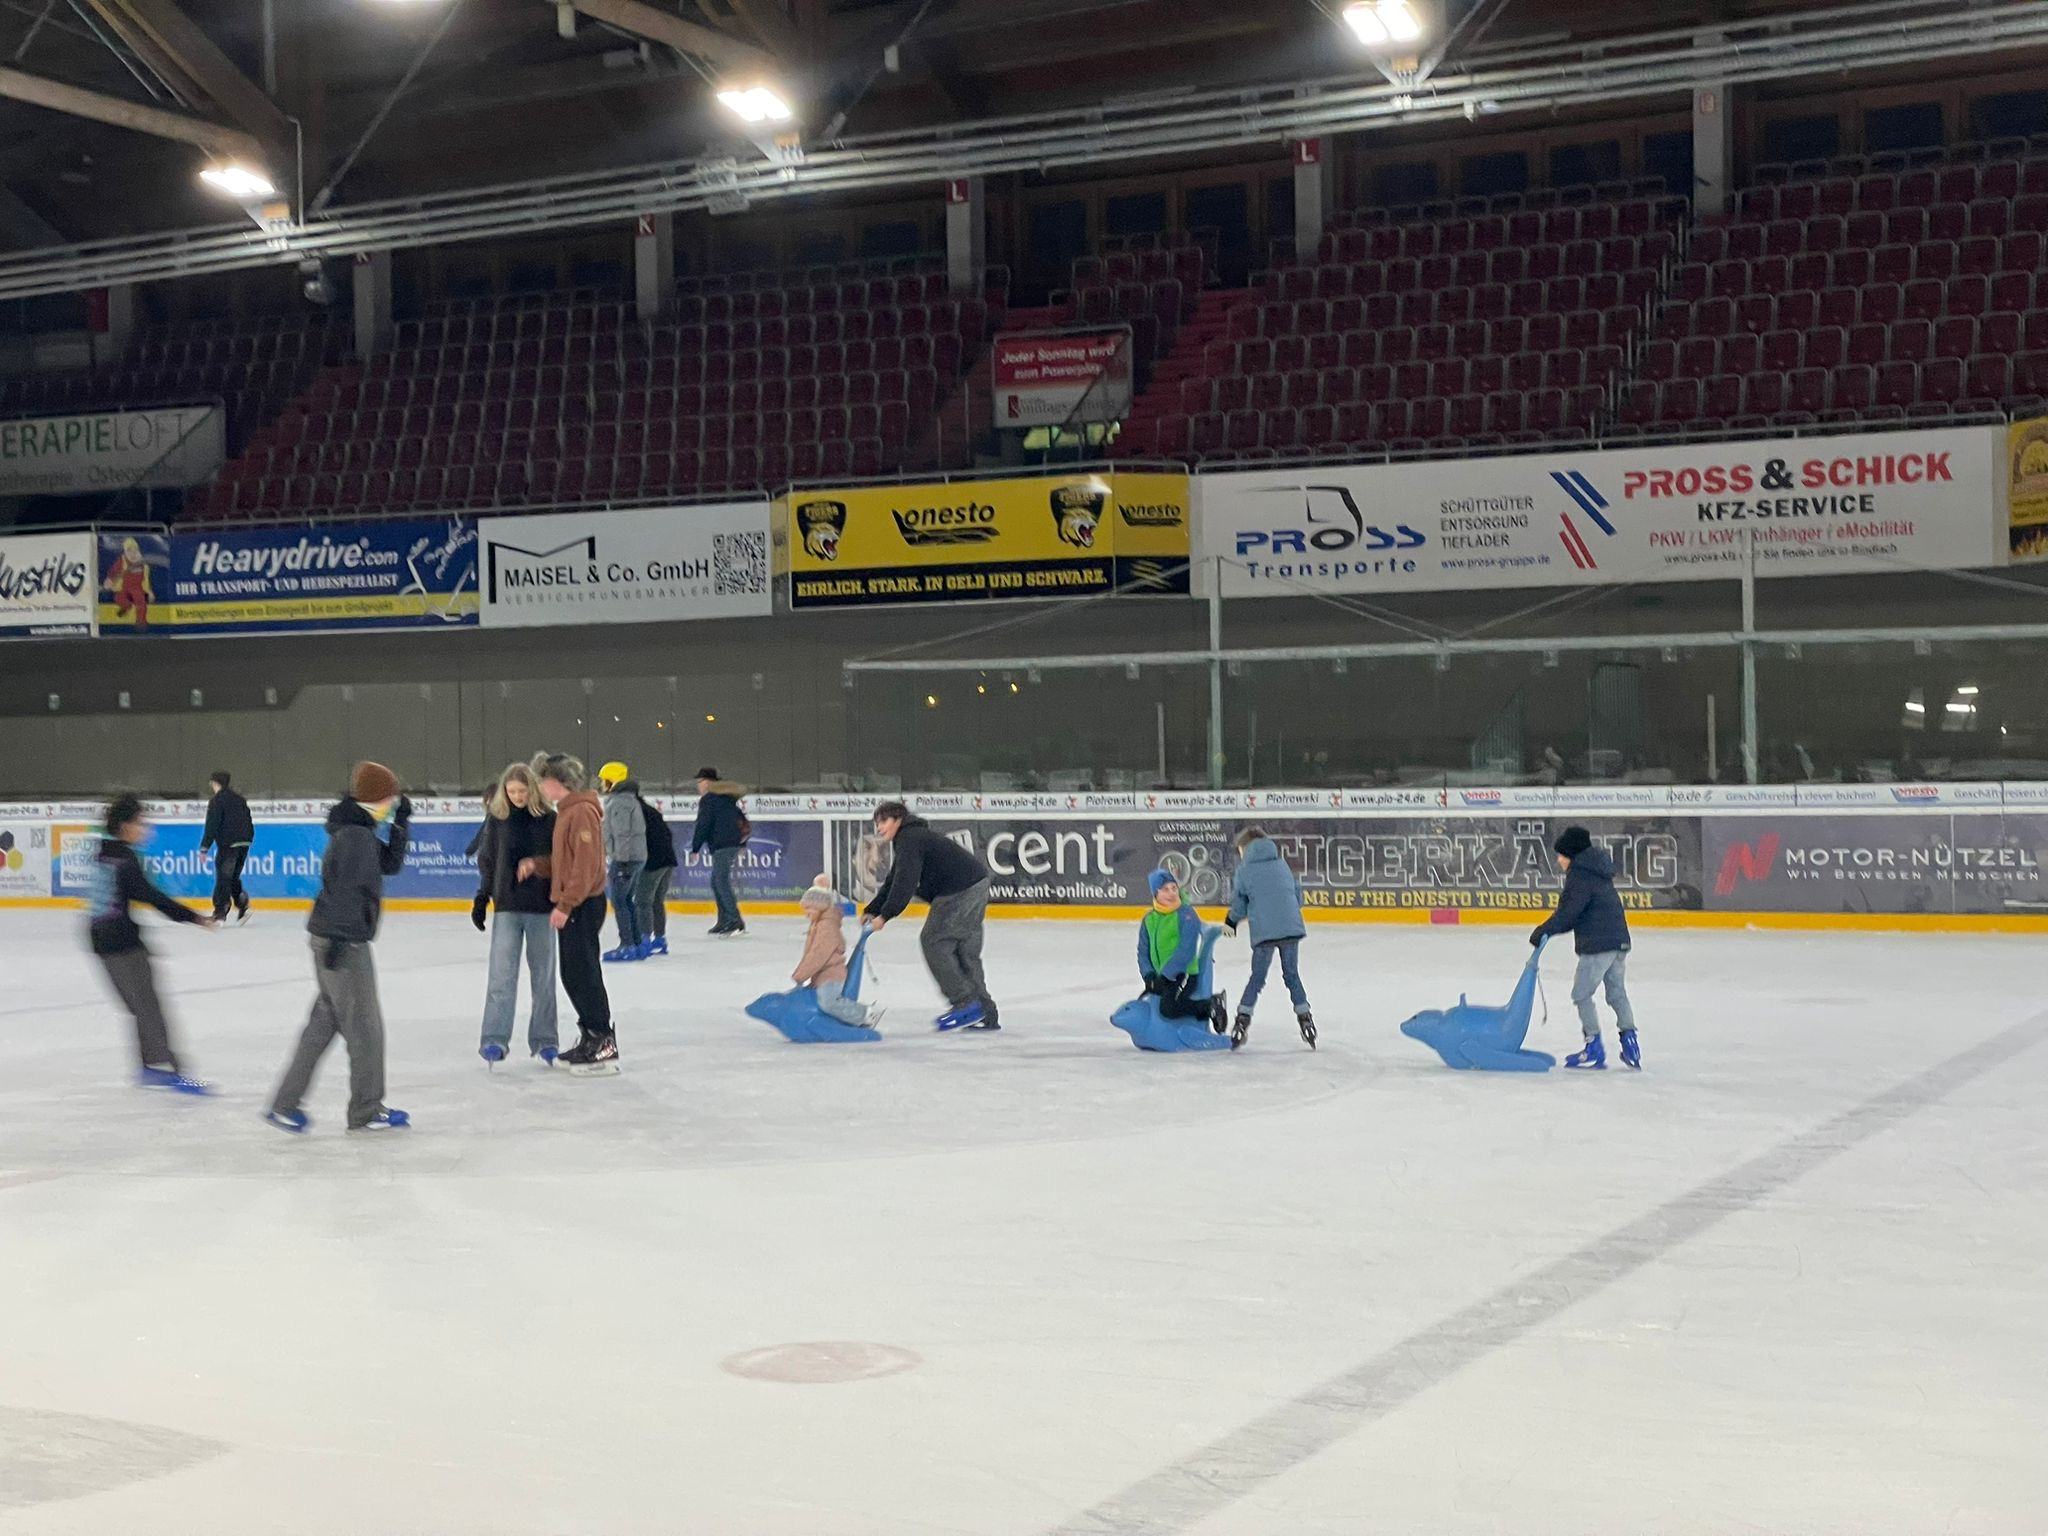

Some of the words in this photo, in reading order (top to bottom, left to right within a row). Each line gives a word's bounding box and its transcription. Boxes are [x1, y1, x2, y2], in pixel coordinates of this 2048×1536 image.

[1302, 142, 1315, 161] L
[952, 182, 963, 200] L
[1624, 465, 1753, 499] PROSS
[1760, 459, 1794, 490] &
[1802, 453, 1953, 489] SCHICK
[907, 503, 995, 526] onesto
[1126, 504, 1180, 518] onesto
[1441, 497, 1534, 514] SCHÜTTGÜTER
[1698, 494, 1874, 522] KFZ-SERVICE
[1441, 515, 1528, 532] ENTSORGUNG
[1649, 532, 1686, 548] PKW
[1699, 529, 1735, 546] LKW
[1836, 521, 1915, 538] eMobilität
[1236, 525, 1426, 556] PROSS
[1442, 534, 1510, 549] TIEFLADER
[505, 566, 580, 588] MAISEL
[587, 564, 600, 584] &
[607, 562, 640, 584] Co.
[647, 556, 709, 581] GmbH
[1247, 556, 1416, 579] Transporte
[797, 580, 865, 597] EHRLICH.
[868, 576, 923, 594] STARK.
[925, 576, 943, 591] IN
[947, 573, 986, 590] GELB
[989, 571, 1023, 587] UND
[1266, 792, 1320, 804] Piotrowski
[987, 822, 1115, 876] cent
[1785, 844, 2038, 867] MOTOR-NÜTZEL
[988, 883, 1127, 900] ww.cent-online.de
[1334, 889, 1356, 906] OF
[1360, 889, 1397, 907] THE
[1401, 889, 1472, 907] ONESTO
[1475, 890, 1543, 908] TIGERS
